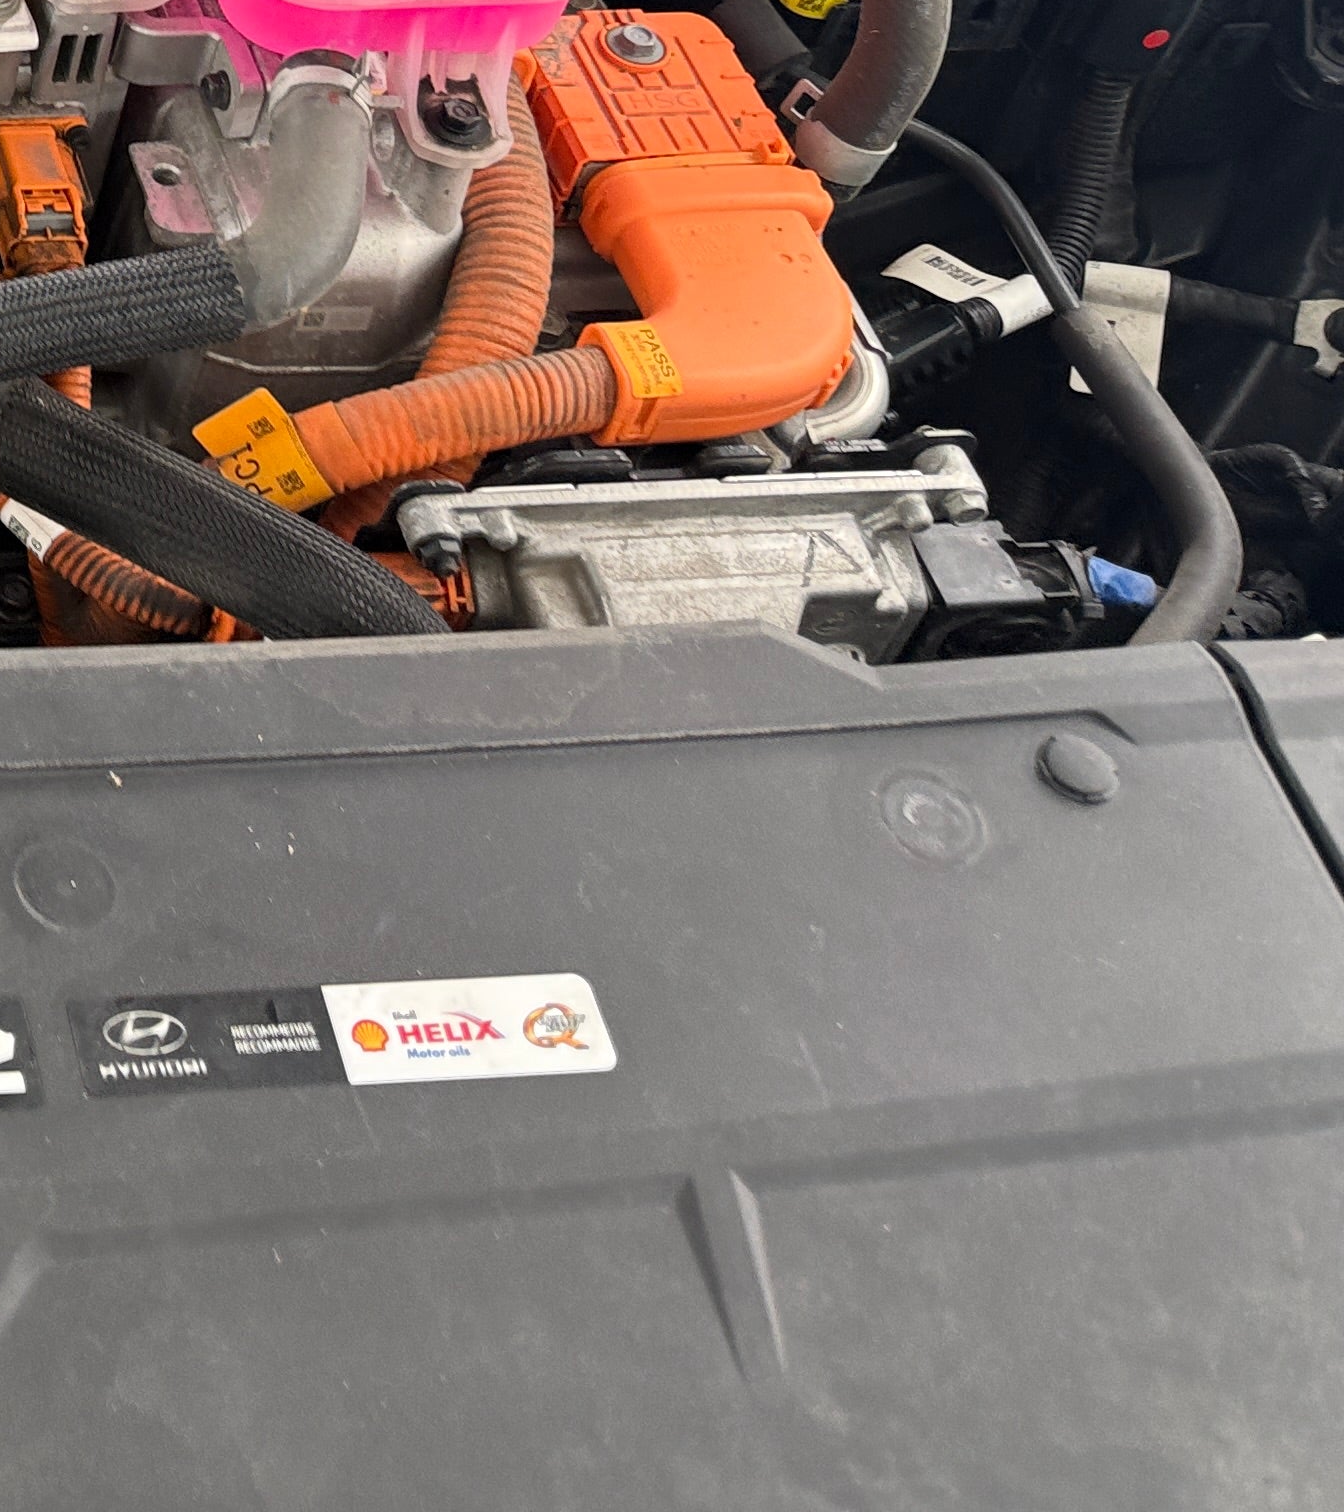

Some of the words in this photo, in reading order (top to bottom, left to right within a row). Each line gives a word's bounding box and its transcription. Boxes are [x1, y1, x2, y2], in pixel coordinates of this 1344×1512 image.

[628, 92, 701, 110] HSG
[639, 329, 676, 378] PASS
[396, 1015, 506, 1045] HELIX
[407, 1046, 446, 1060] Motor
[448, 1045, 471, 1059] oils
[98, 1056, 208, 1081] HYUNDAI
